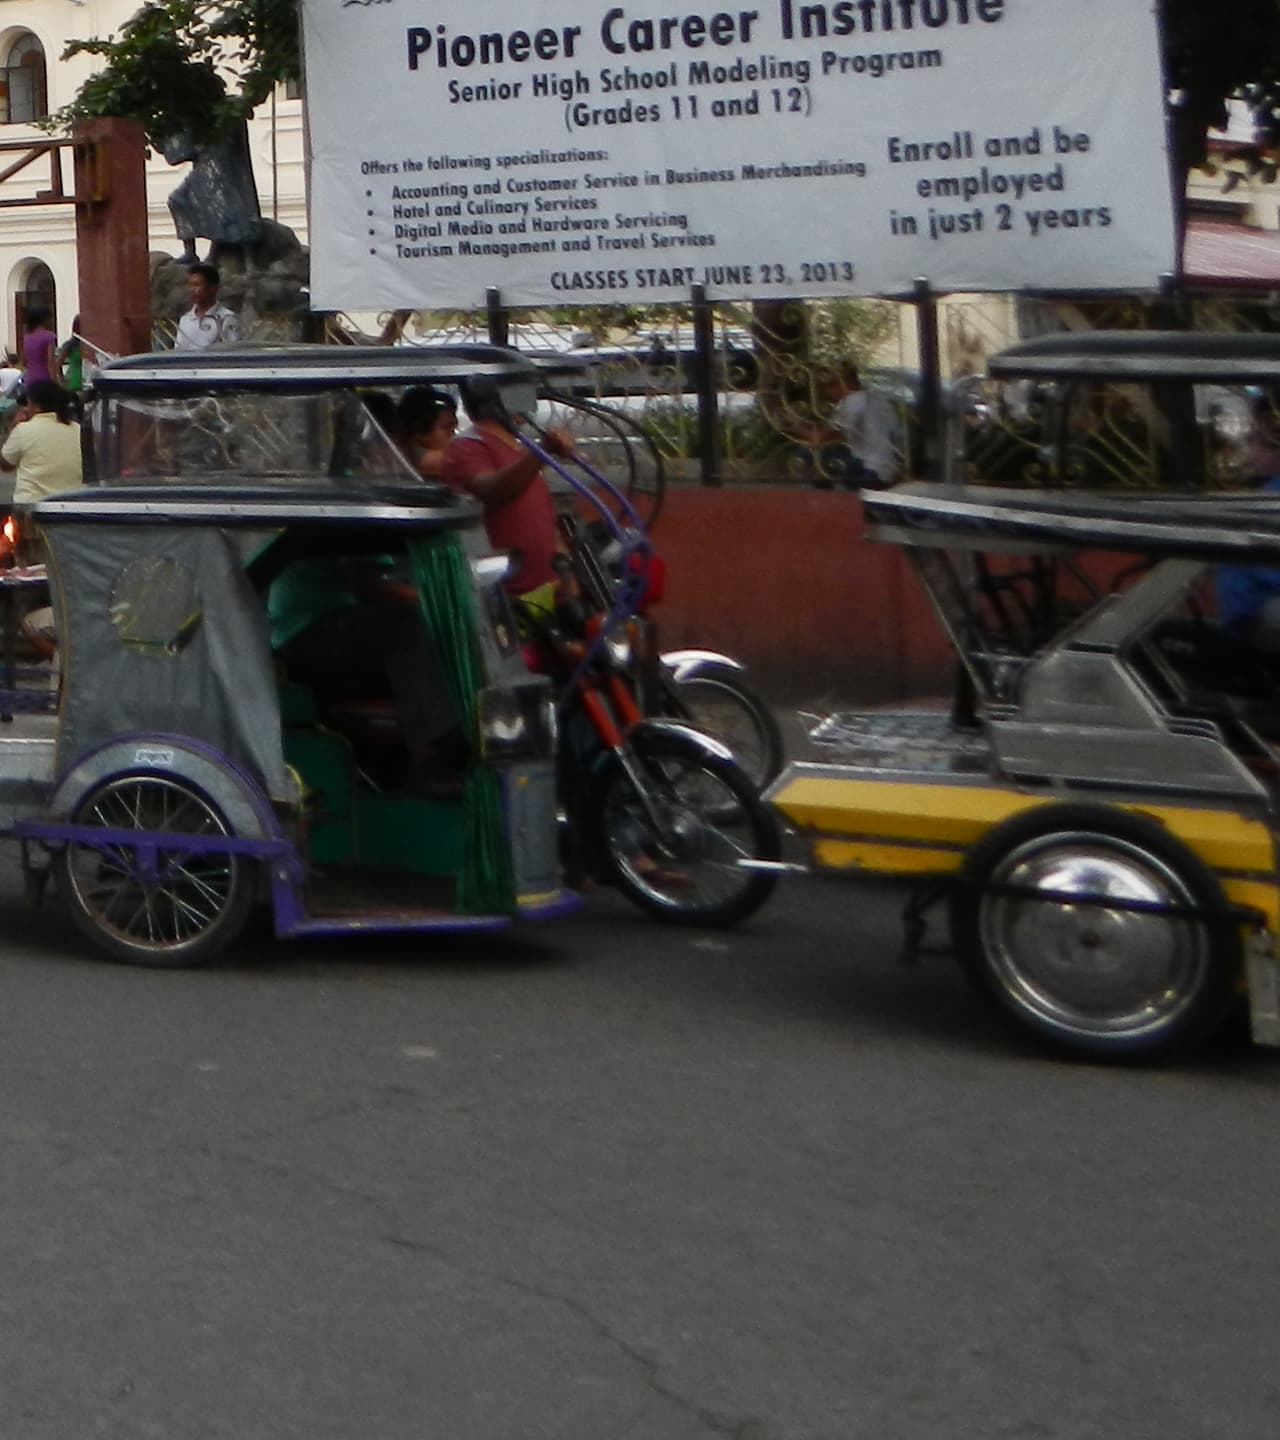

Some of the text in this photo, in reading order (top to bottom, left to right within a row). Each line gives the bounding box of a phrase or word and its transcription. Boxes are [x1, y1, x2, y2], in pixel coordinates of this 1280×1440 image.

[407, 24, 581, 70] Pioneer
[601, 7, 759, 54] Career
[448, 49, 942, 104] Senior High School Modeling Program
[564, 87, 812, 133] (Grades 11 and 12)
[361, 148, 609, 175] Offers the following specializations:
[887, 125, 1091, 163] Enroll and be
[392, 159, 866, 200] Accounting and Customer Service in Business Merchandising
[916, 163, 1065, 202] employed
[393, 195, 598, 219] Hotel and Culinary Services
[394, 211, 688, 241] Digital Media and Hardware Servicing
[890, 203, 1112, 241] in just 2 years
[396, 231, 716, 259] Tourism Management and Travel Services
[550, 261, 855, 290] CLASSES START JUNE 23, 2013
